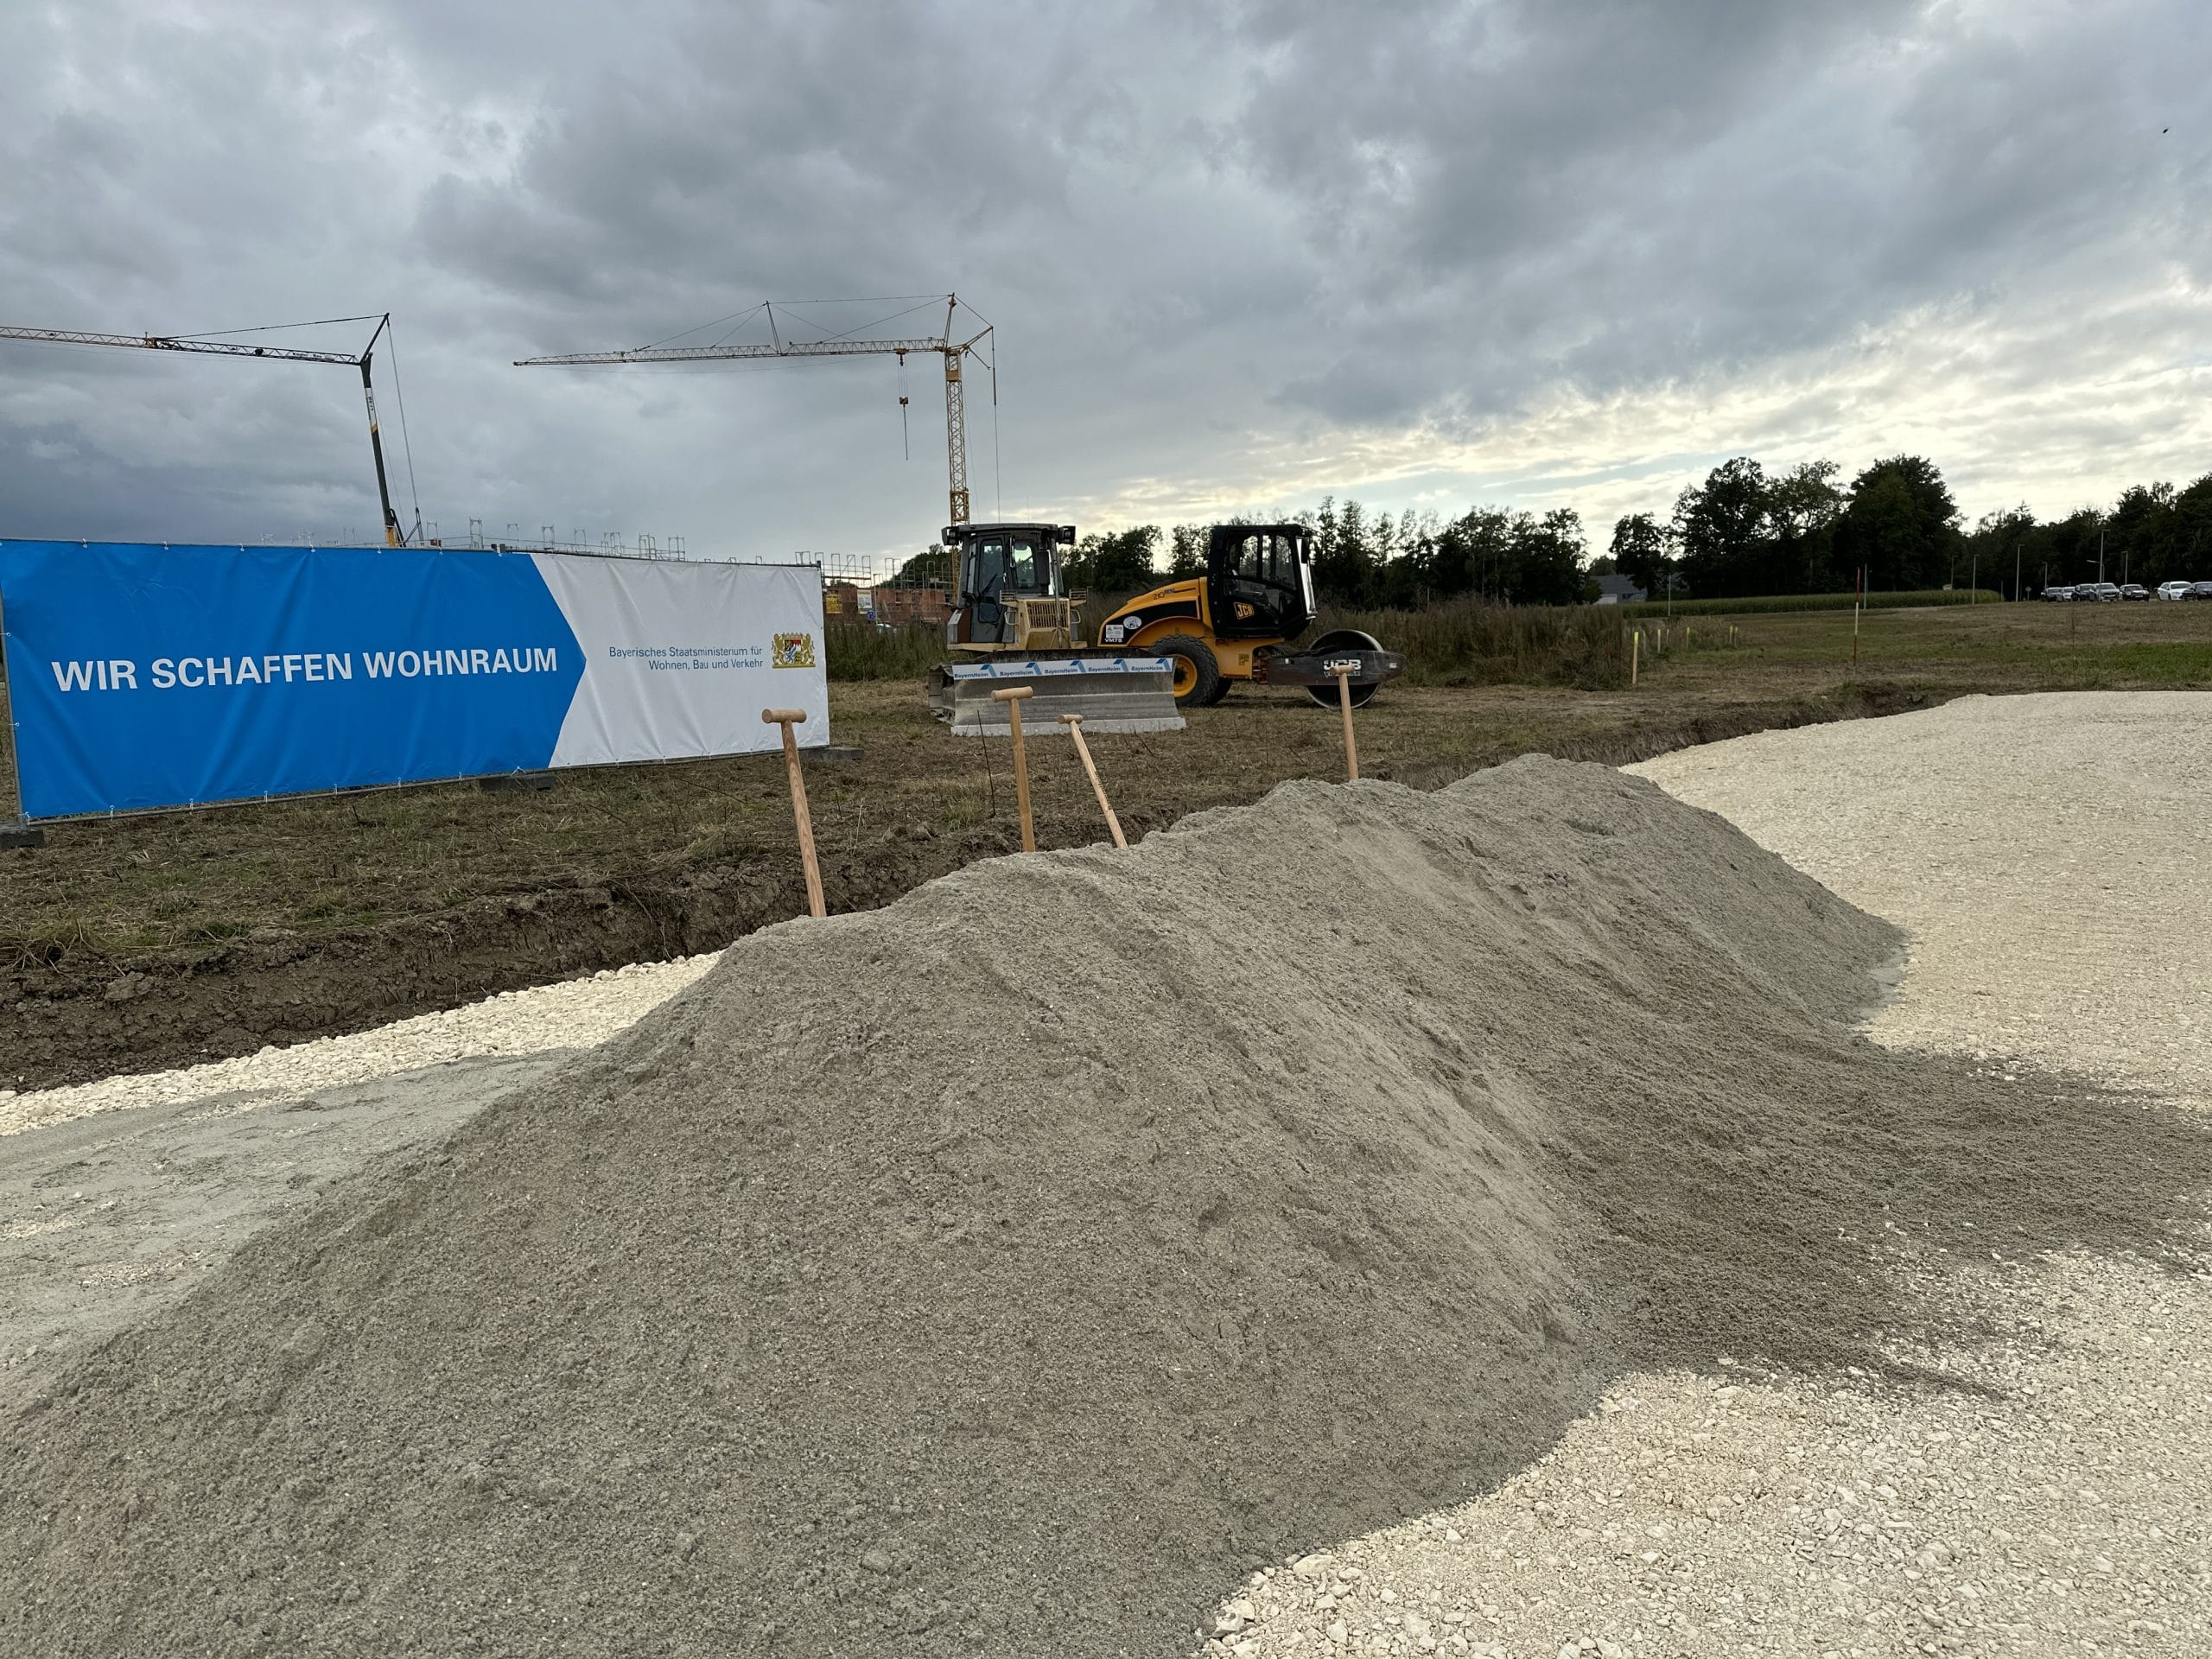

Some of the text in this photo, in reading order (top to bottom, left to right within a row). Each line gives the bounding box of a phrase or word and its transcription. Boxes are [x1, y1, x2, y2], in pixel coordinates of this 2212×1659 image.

[1236, 604, 1253, 618] JCB
[609, 645, 763, 659] Bayerisches Staatsministerium für
[51, 648, 557, 691] WIR SCHAFFEN WOHNRAUM
[648, 658, 763, 671] Wohnen, Bau und Verkehr
